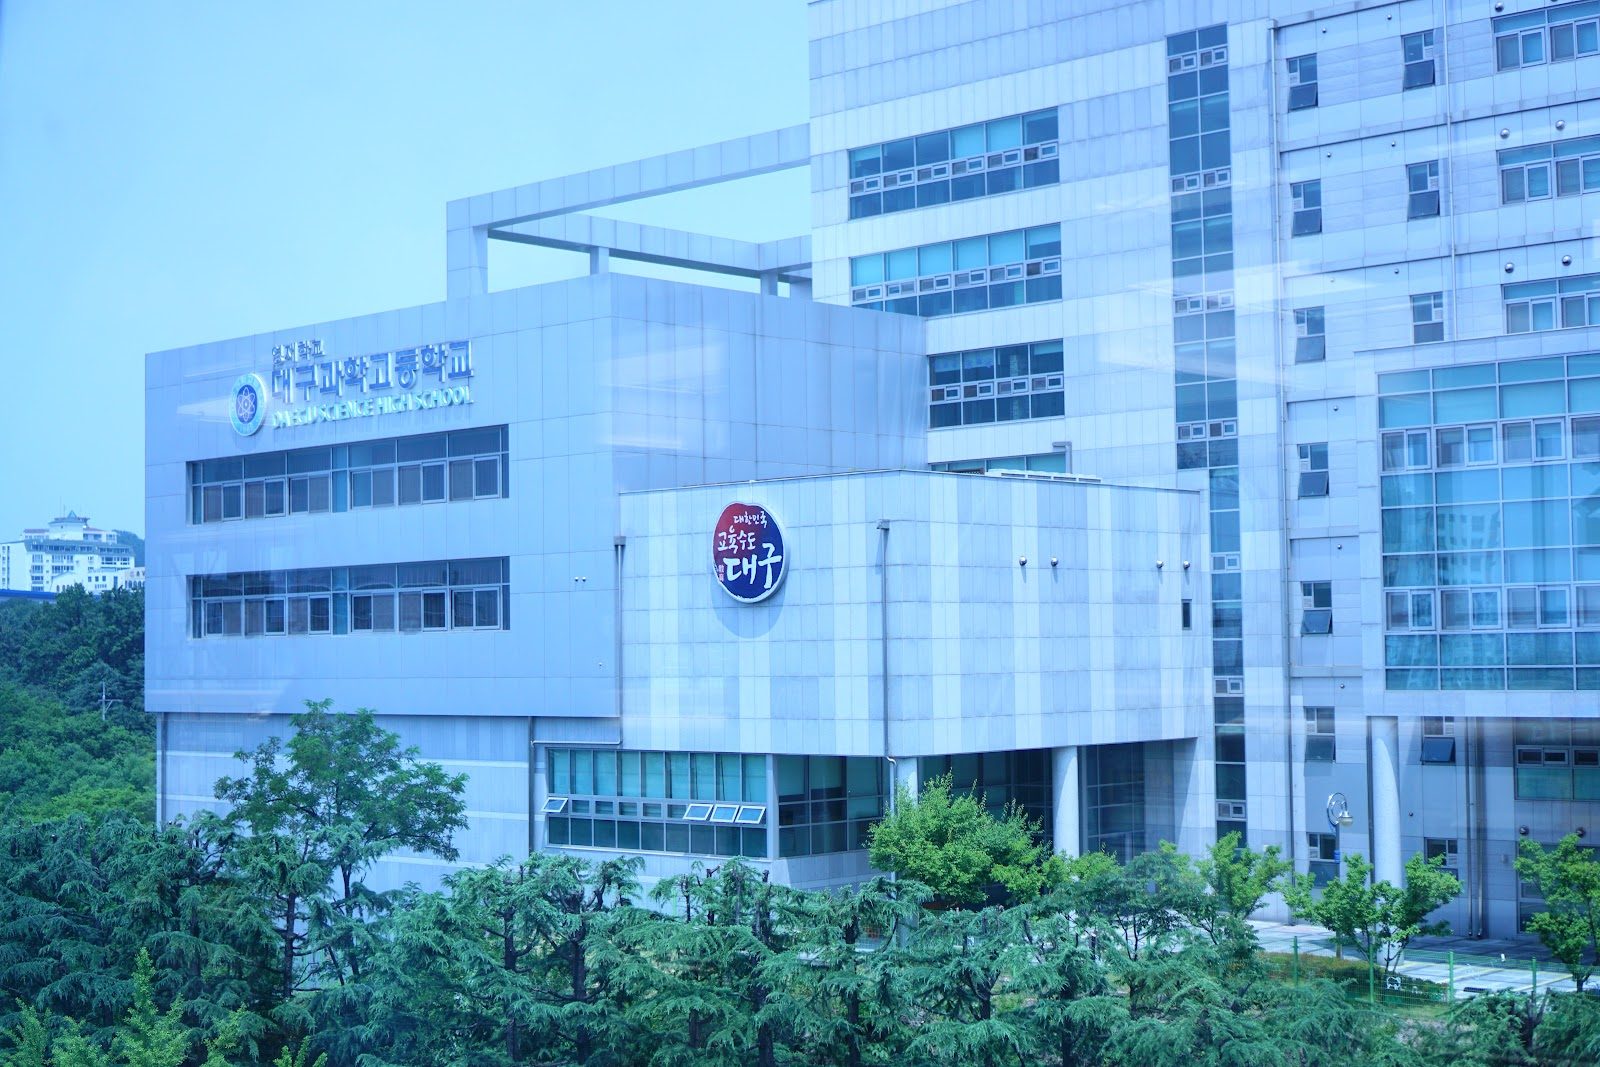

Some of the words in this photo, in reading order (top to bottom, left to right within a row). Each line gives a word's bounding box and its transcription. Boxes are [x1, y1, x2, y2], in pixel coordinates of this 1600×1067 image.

[272, 339, 325, 365] 영재학교
[271, 340, 474, 404] 대구과학고등학교
[272, 406, 316, 429] DAEGU
[318, 398, 373, 422] SCIENCE
[377, 392, 412, 414] HIGH
[415, 385, 474, 410] SCHOOL
[733, 510, 768, 528] 대한민국
[717, 525, 756, 554] 교육수도
[722, 542, 782, 589] 대구
